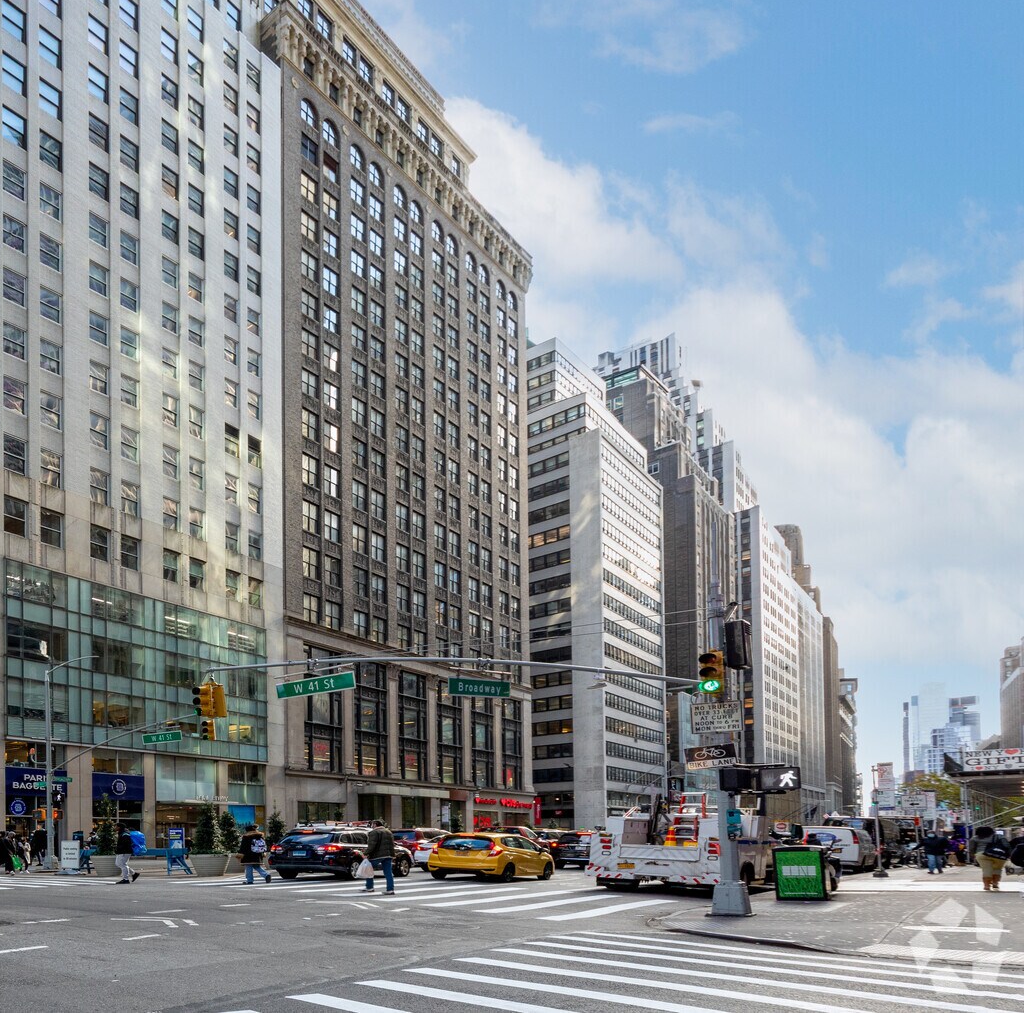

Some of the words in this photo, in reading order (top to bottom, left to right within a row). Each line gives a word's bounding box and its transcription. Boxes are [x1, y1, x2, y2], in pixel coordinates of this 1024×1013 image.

[294, 683, 303, 693] W
[308, 681, 319, 691] 41
[323, 678, 335, 689] St
[458, 682, 501, 695] Broadway
[712, 758, 734, 766] LANE
